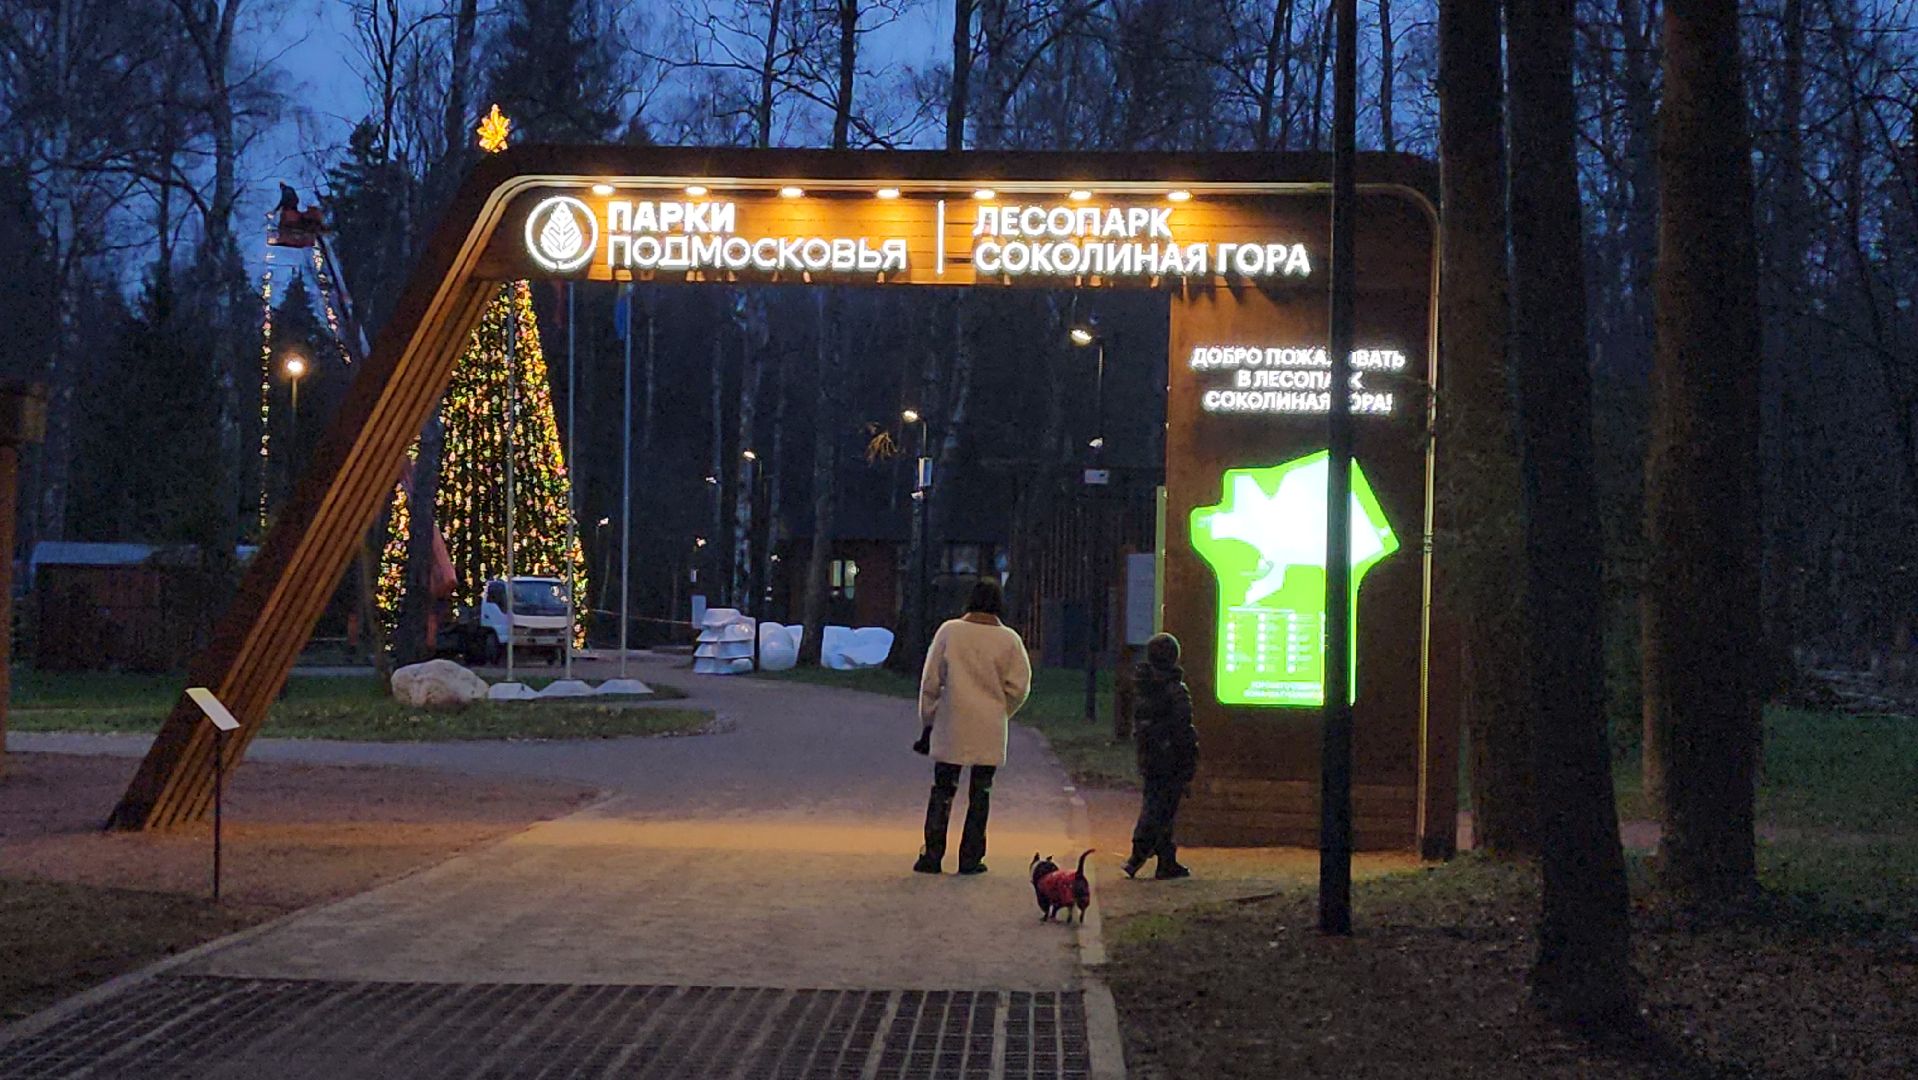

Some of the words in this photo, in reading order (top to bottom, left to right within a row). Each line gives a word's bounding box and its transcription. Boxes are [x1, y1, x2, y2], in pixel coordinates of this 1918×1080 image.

[607, 201, 735, 233] ПАРКИ
[973, 206, 1172, 237] ЛЕСОПАРК
[607, 235, 907, 270] ПОДМОСКОВЬЯ
[975, 241, 1207, 274] СОКОЛИНАЯ
[1217, 243, 1311, 274] ГОРА
[1191, 347, 1263, 368] ДОБРО
[1266, 348, 1406, 369] ПОЖАВАТЬ
[1237, 370, 1252, 387] В
[1253, 371, 1364, 389] ЛЕСОПК
[1205, 391, 1332, 410] СОКОЛИНАЯ
[1347, 392, 1393, 411] ОРА!
